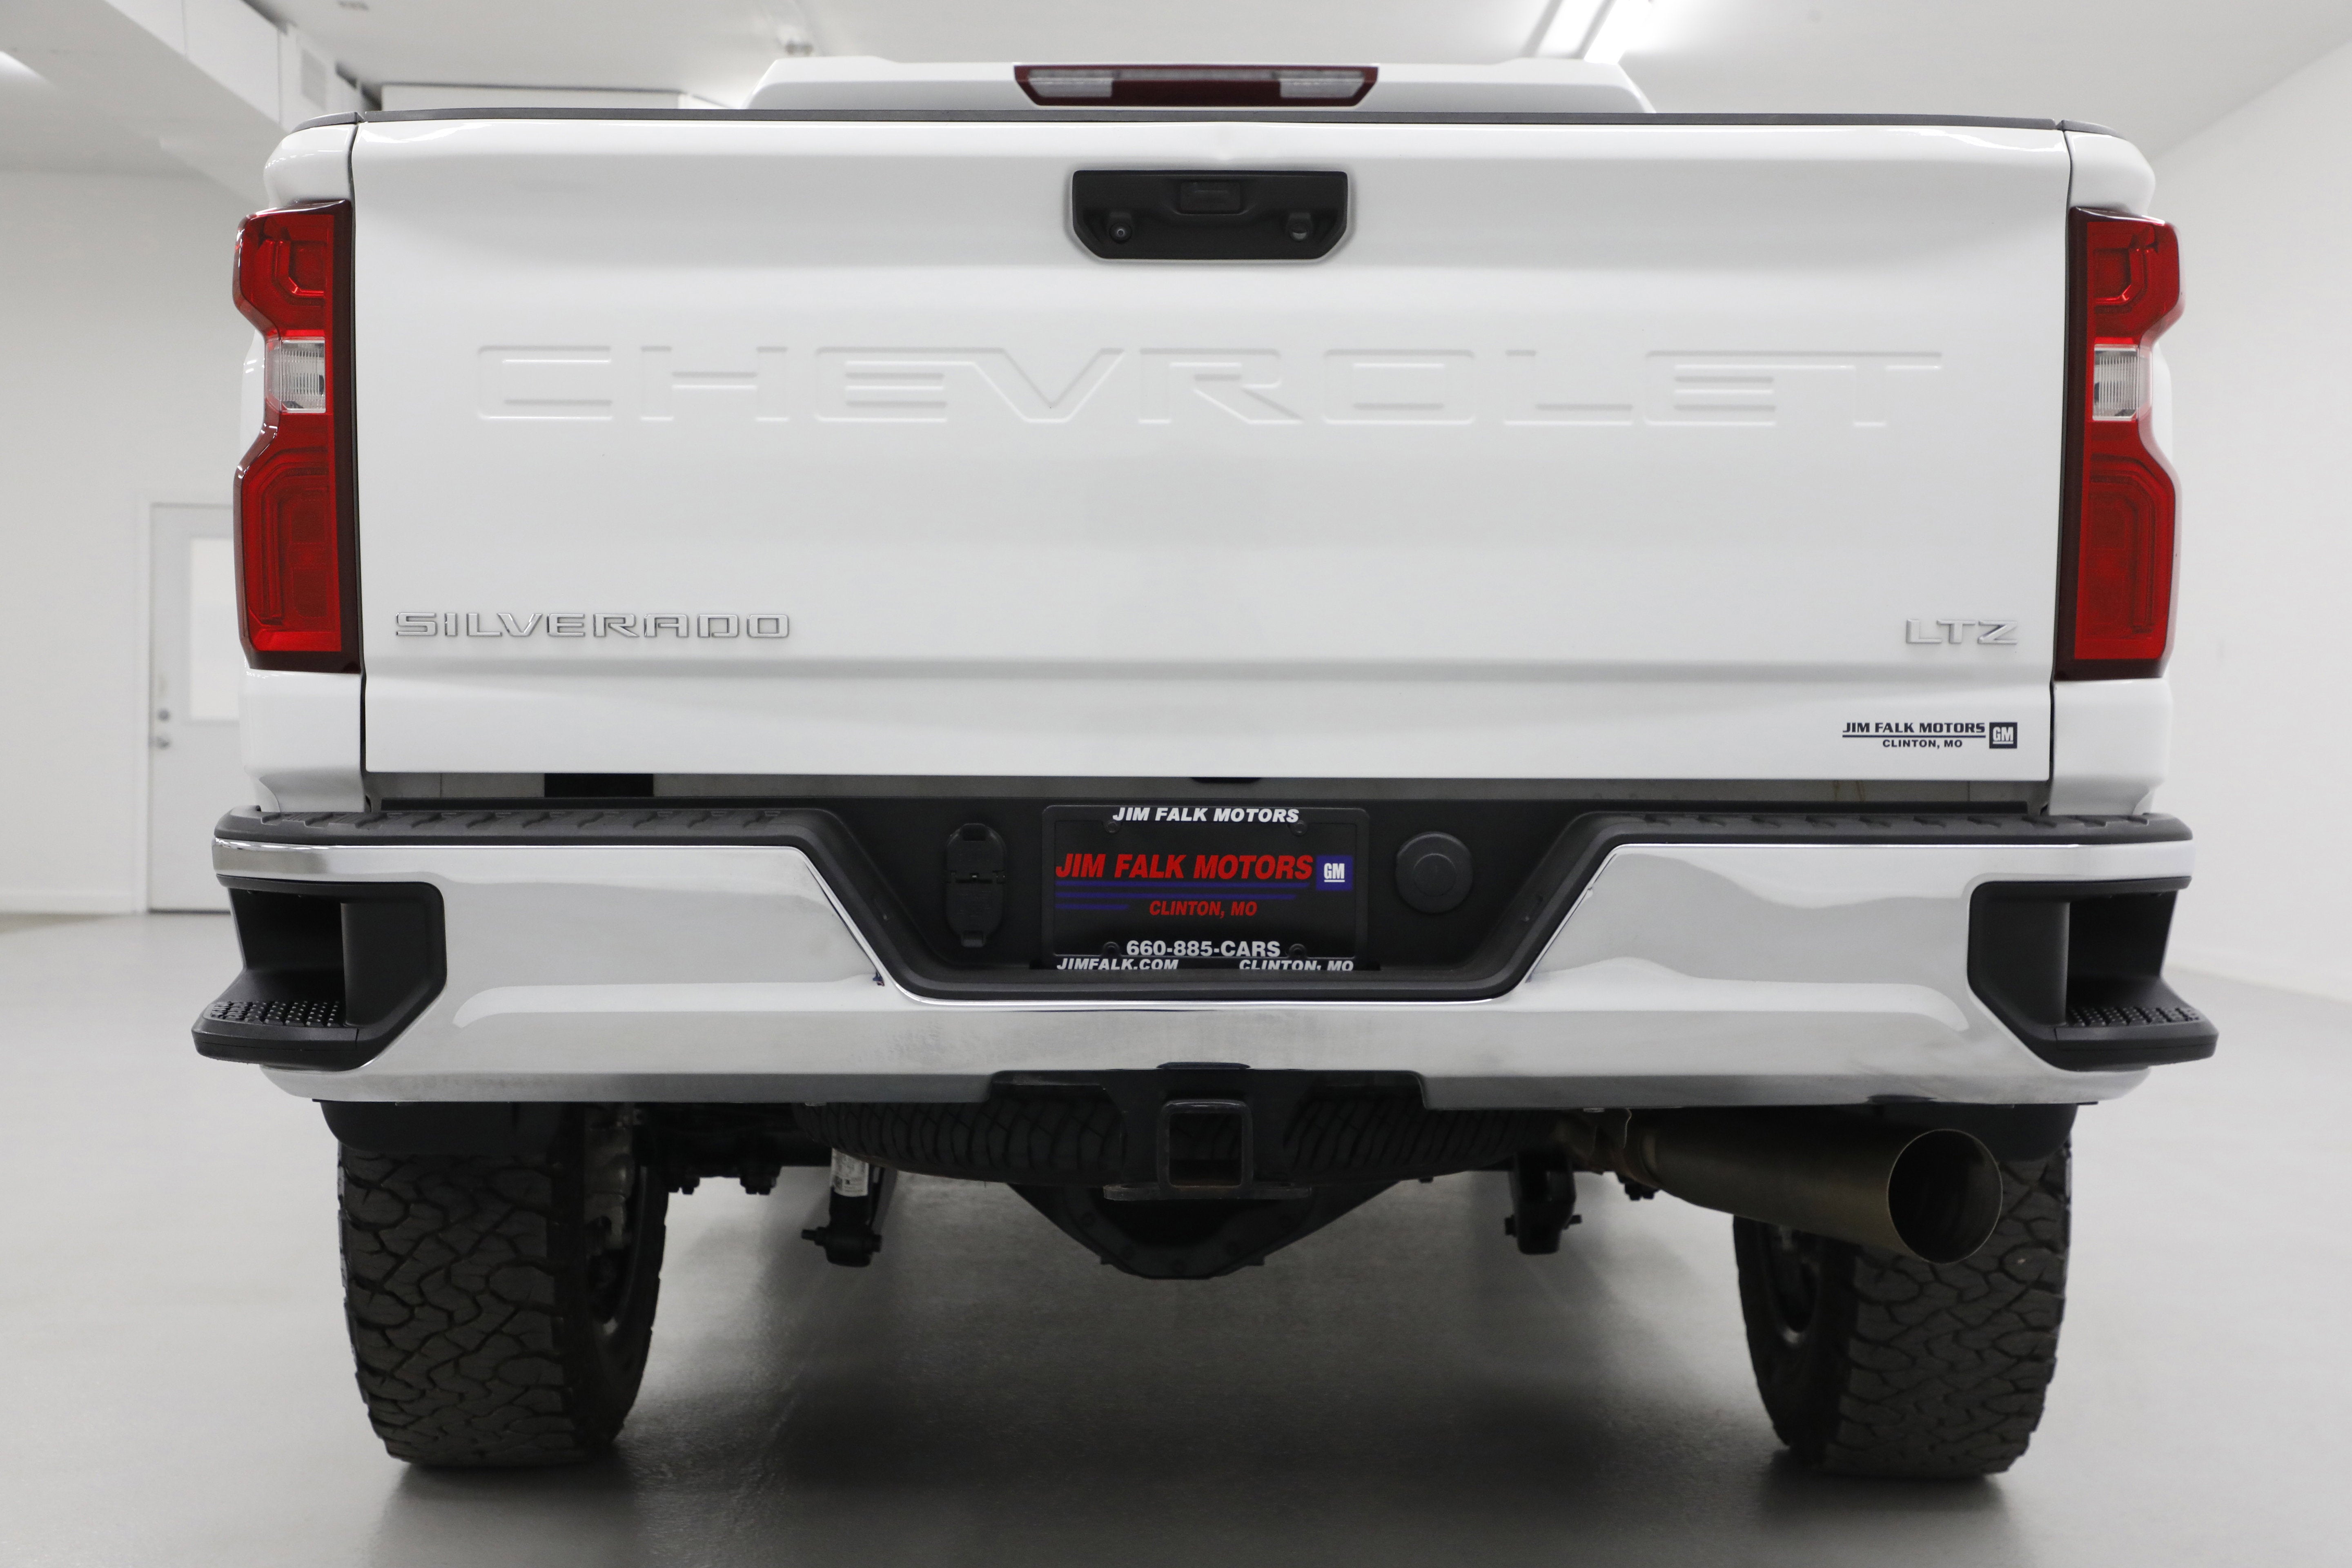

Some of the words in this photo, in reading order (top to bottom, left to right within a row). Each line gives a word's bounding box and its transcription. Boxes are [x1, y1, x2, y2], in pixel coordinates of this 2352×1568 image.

[476, 345, 1942, 427] CHEVROLET
[396, 613, 789, 639] SILVERADO
[1906, 619, 2018, 645] LTZ
[1843, 722, 1870, 733] JIM
[1875, 722, 1914, 733] FALK
[1919, 723, 1985, 733] MOTORS
[1993, 726, 2013, 742] GM
[1883, 739, 1940, 749] CLINTON,
[1944, 739, 1962, 748] MO
[1112, 807, 1151, 821] JIM
[1155, 807, 1208, 822] FALK
[1213, 808, 1299, 823] MOTORS
[1056, 853, 1107, 878] JIM
[1114, 854, 1187, 878] FALK
[1193, 854, 1314, 880] MOTORS
[1323, 862, 1345, 880] GM
[1149, 900, 1225, 918] CLINTON,
[1231, 901, 1258, 916] MO
[1126, 940, 1281, 958] 660-885-CARS
[1057, 958, 1179, 970] JIMFALK.COM
[1239, 959, 1321, 971] CLINTON,
[1327, 960, 1354, 971] MO
